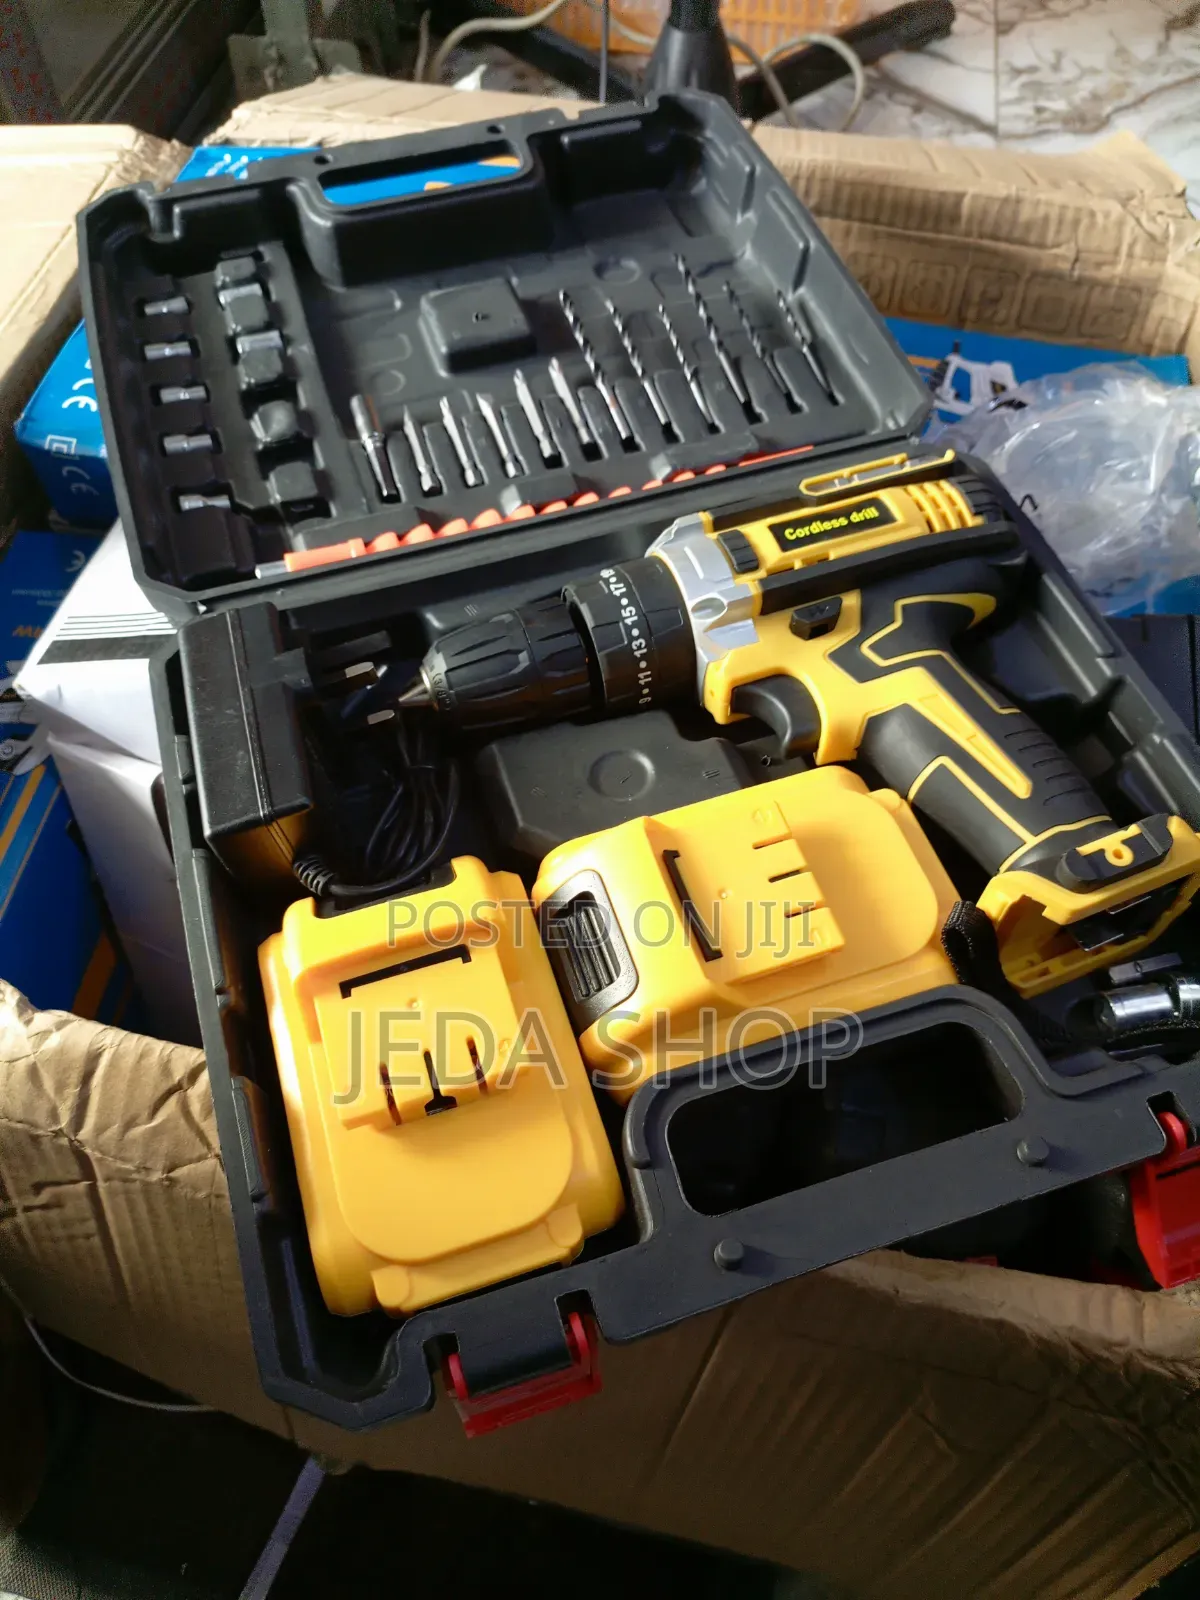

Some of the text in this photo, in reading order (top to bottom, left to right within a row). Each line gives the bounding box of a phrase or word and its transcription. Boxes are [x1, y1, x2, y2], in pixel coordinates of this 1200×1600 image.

[784, 506, 880, 541] Cordless drill
[609, 582, 627, 597] 17
[620, 605, 639, 626] 15
[631, 637, 648, 659] 13
[637, 670, 652, 686] 11
